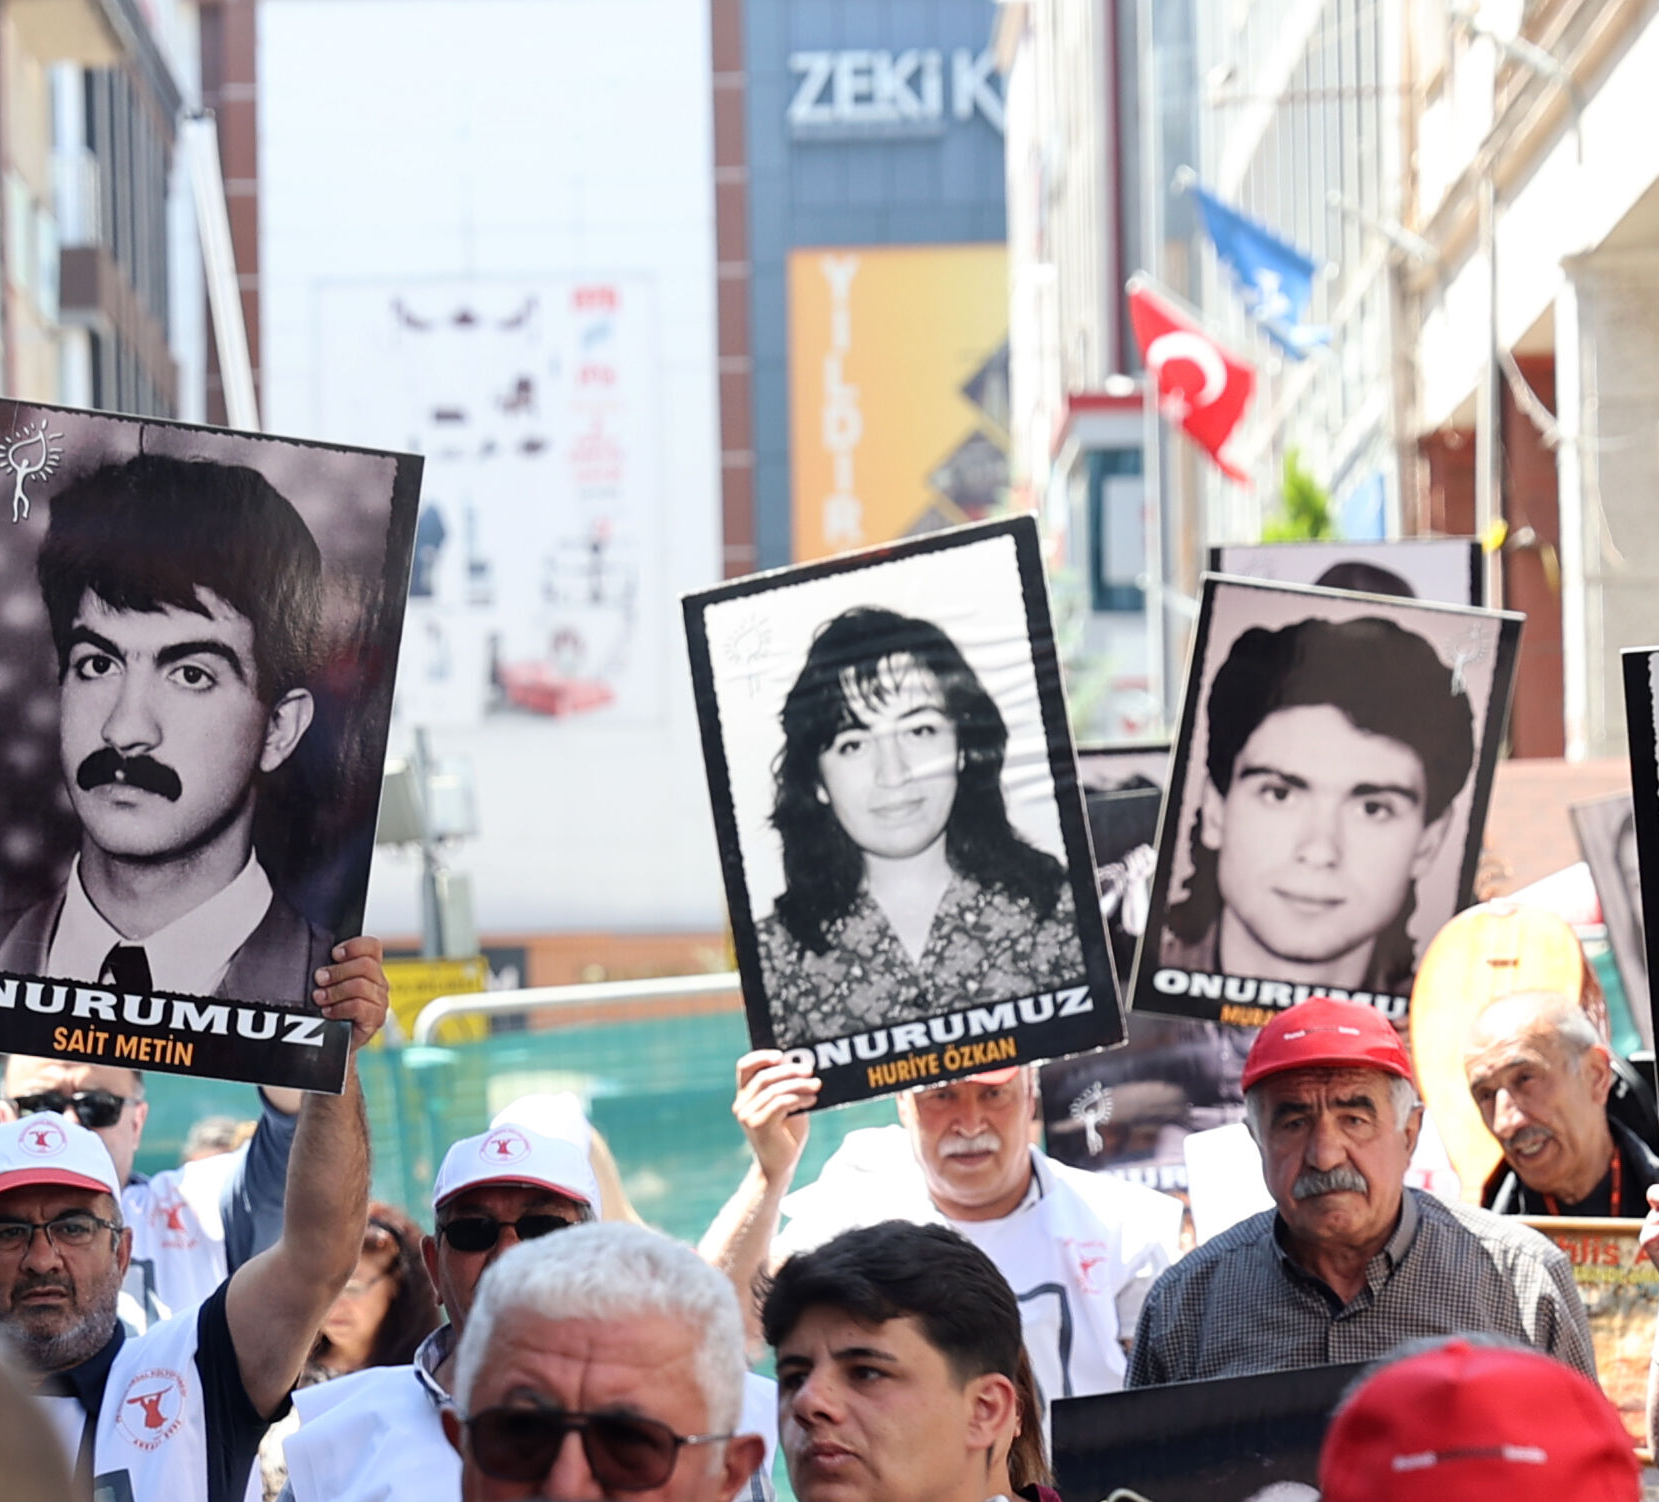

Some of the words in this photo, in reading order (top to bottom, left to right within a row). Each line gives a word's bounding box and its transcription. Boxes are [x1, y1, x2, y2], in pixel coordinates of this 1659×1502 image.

[951, 47, 1008, 134] K
[821, 253, 864, 545] YILDIR
[1152, 967, 1410, 1021] ONURUU
[52, 1024, 110, 1057] SAİT
[125, 1033, 194, 1067] METİN
[783, 985, 1094, 1071] ONURUMUZ
[866, 1052, 940, 1089] HURİYE
[942, 1037, 1018, 1072] ÖZKAN
[1557, 1234, 1621, 1266] hlis
